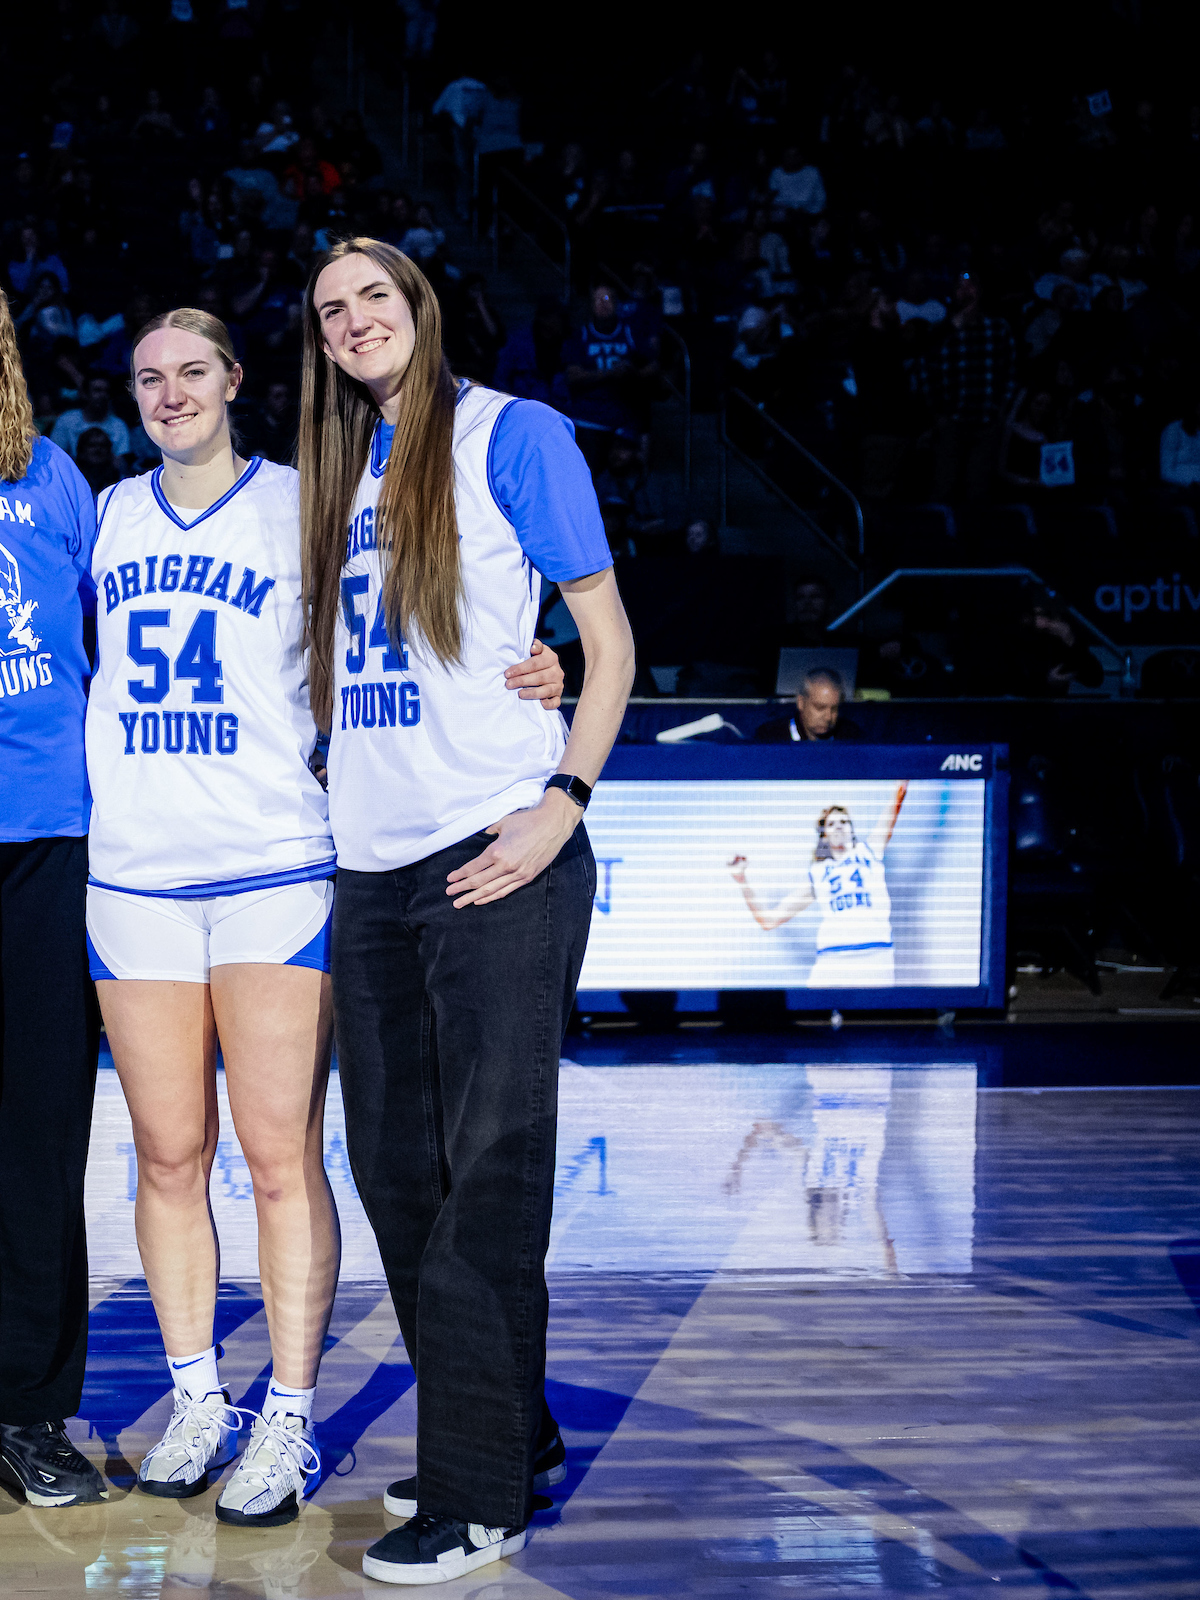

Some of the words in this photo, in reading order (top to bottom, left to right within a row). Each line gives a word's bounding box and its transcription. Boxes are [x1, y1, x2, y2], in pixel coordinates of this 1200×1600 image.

[103, 554, 276, 619] BRIGHAM
[341, 574, 409, 674] 54
[127, 609, 224, 704] 54
[119, 711, 239, 755] YOUNG
[341, 681, 421, 730] YOUNG
[940, 753, 983, 771] ANC
